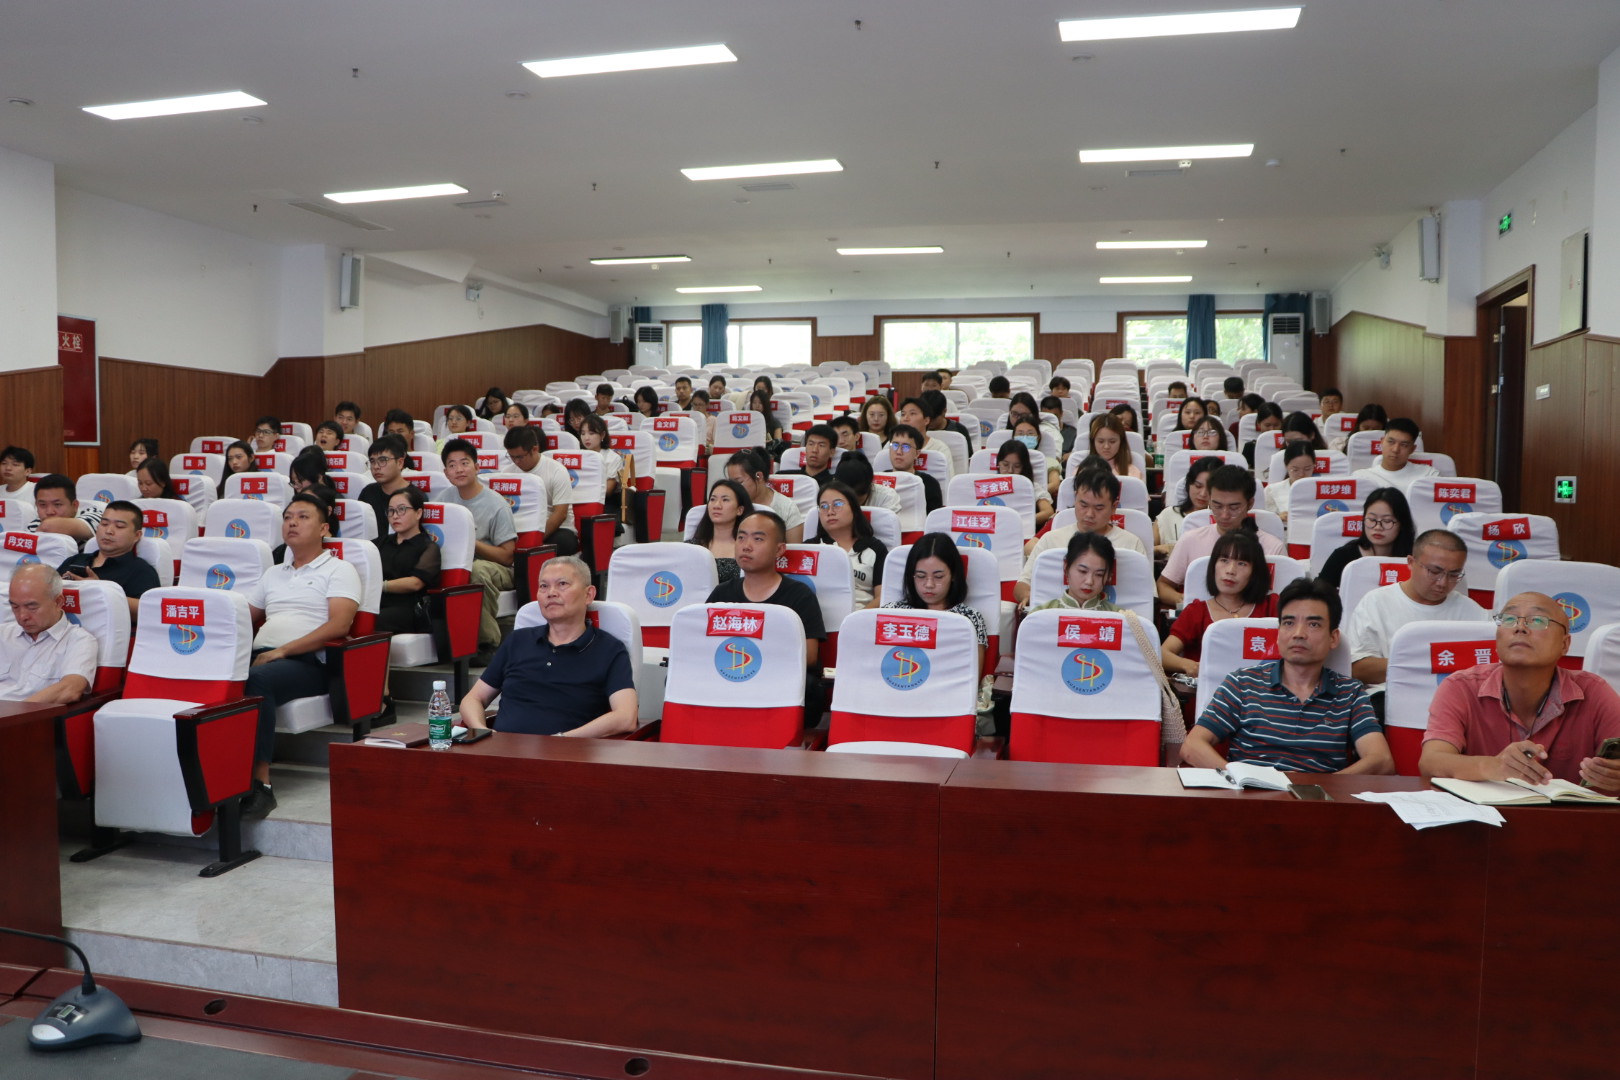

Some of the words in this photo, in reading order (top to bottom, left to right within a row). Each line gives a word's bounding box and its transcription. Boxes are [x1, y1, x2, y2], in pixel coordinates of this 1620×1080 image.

[1438, 488, 1472, 499] 陈奕君
[956, 516, 991, 528] 江佳艺
[1487, 522, 1526, 536] 杨欣
[165, 604, 200, 619] 潘吉平
[712, 615, 758, 632] 赵海林
[882, 622, 930, 641] 李玉德
[1064, 624, 1116, 642] 侯靖
[1250, 636, 1266, 653] 袁
[1437, 648, 1492, 667] 余晋
